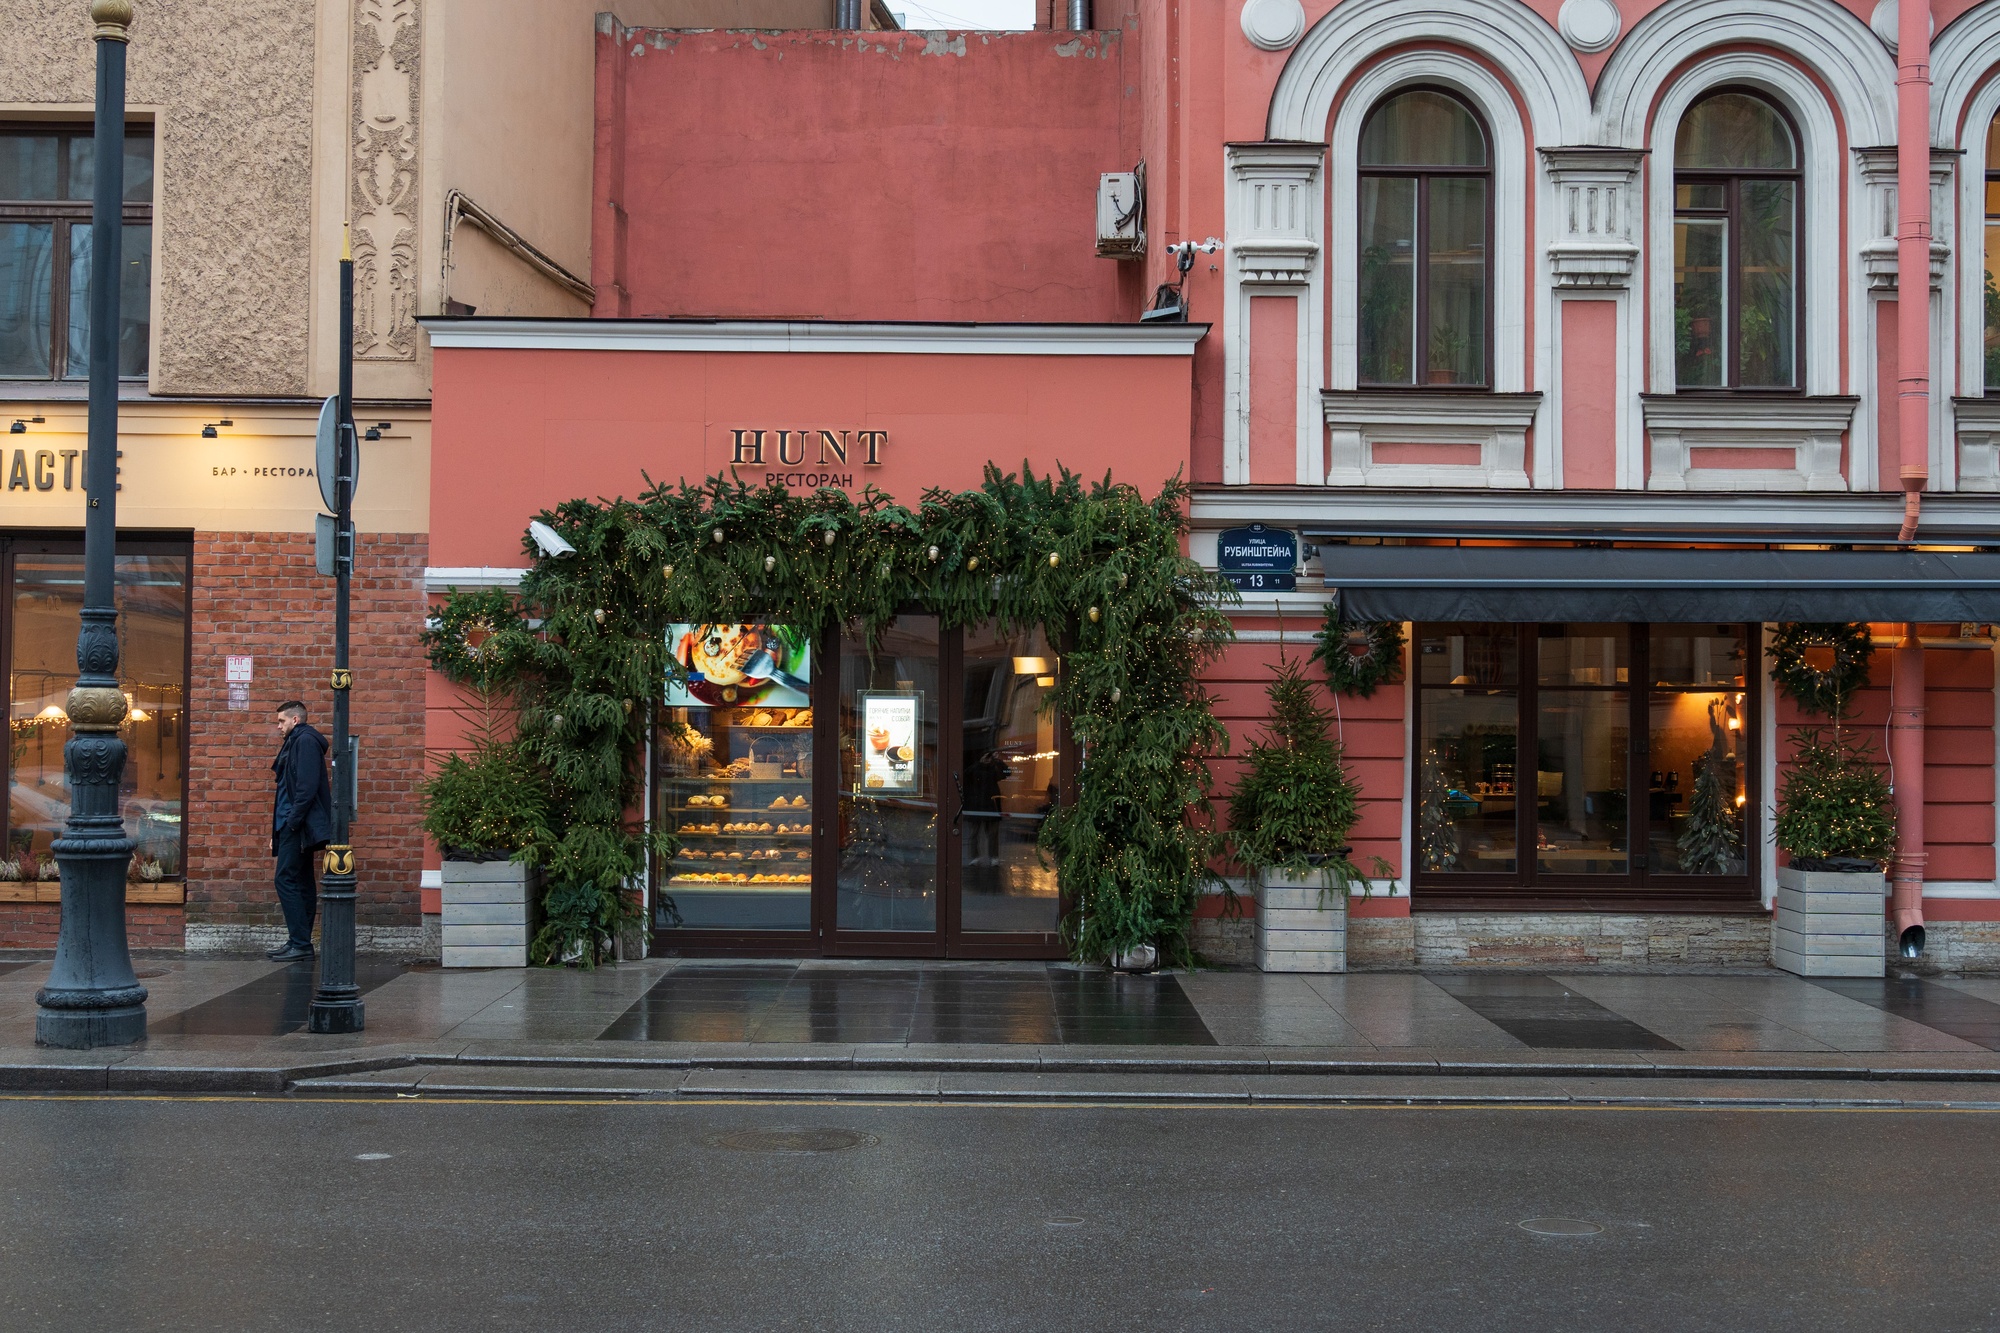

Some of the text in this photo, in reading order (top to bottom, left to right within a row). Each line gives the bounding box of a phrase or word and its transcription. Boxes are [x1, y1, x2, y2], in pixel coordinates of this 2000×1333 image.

[729, 429, 889, 465] HUNT
[212, 467, 318, 477] БАР РЕСТОРА
[766, 473, 852, 487] РЕСТОРАН
[1224, 545, 1291, 557] РУБИНШТЕЙНА
[1249, 574, 1264, 587] 13
[234, 657, 245, 665] ПГ
